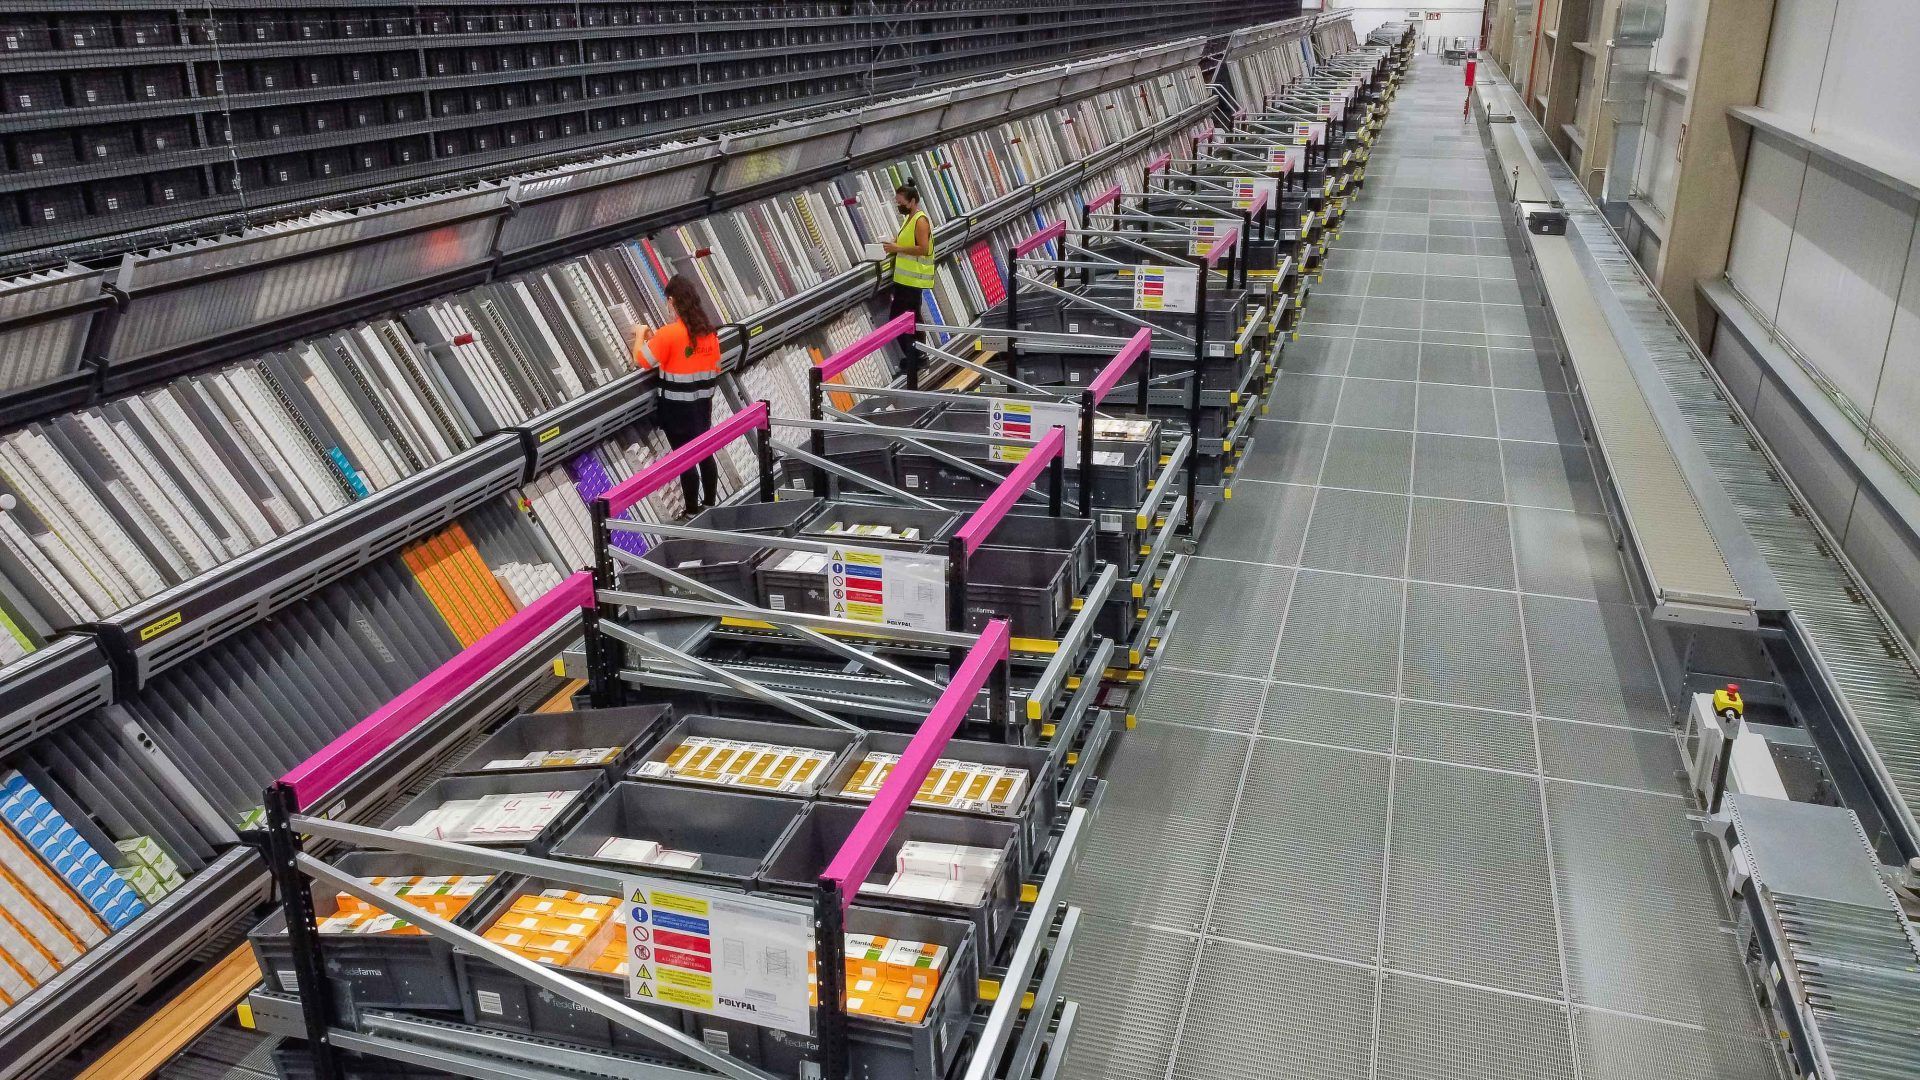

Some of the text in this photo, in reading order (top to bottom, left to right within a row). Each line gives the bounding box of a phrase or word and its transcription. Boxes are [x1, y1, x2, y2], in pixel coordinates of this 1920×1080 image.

[850, 939, 883, 949] Plantaben
[900, 946, 934, 956] Plantaben
[718, 997, 757, 1011] POLYPAL
[784, 1037, 820, 1050] fedefar
